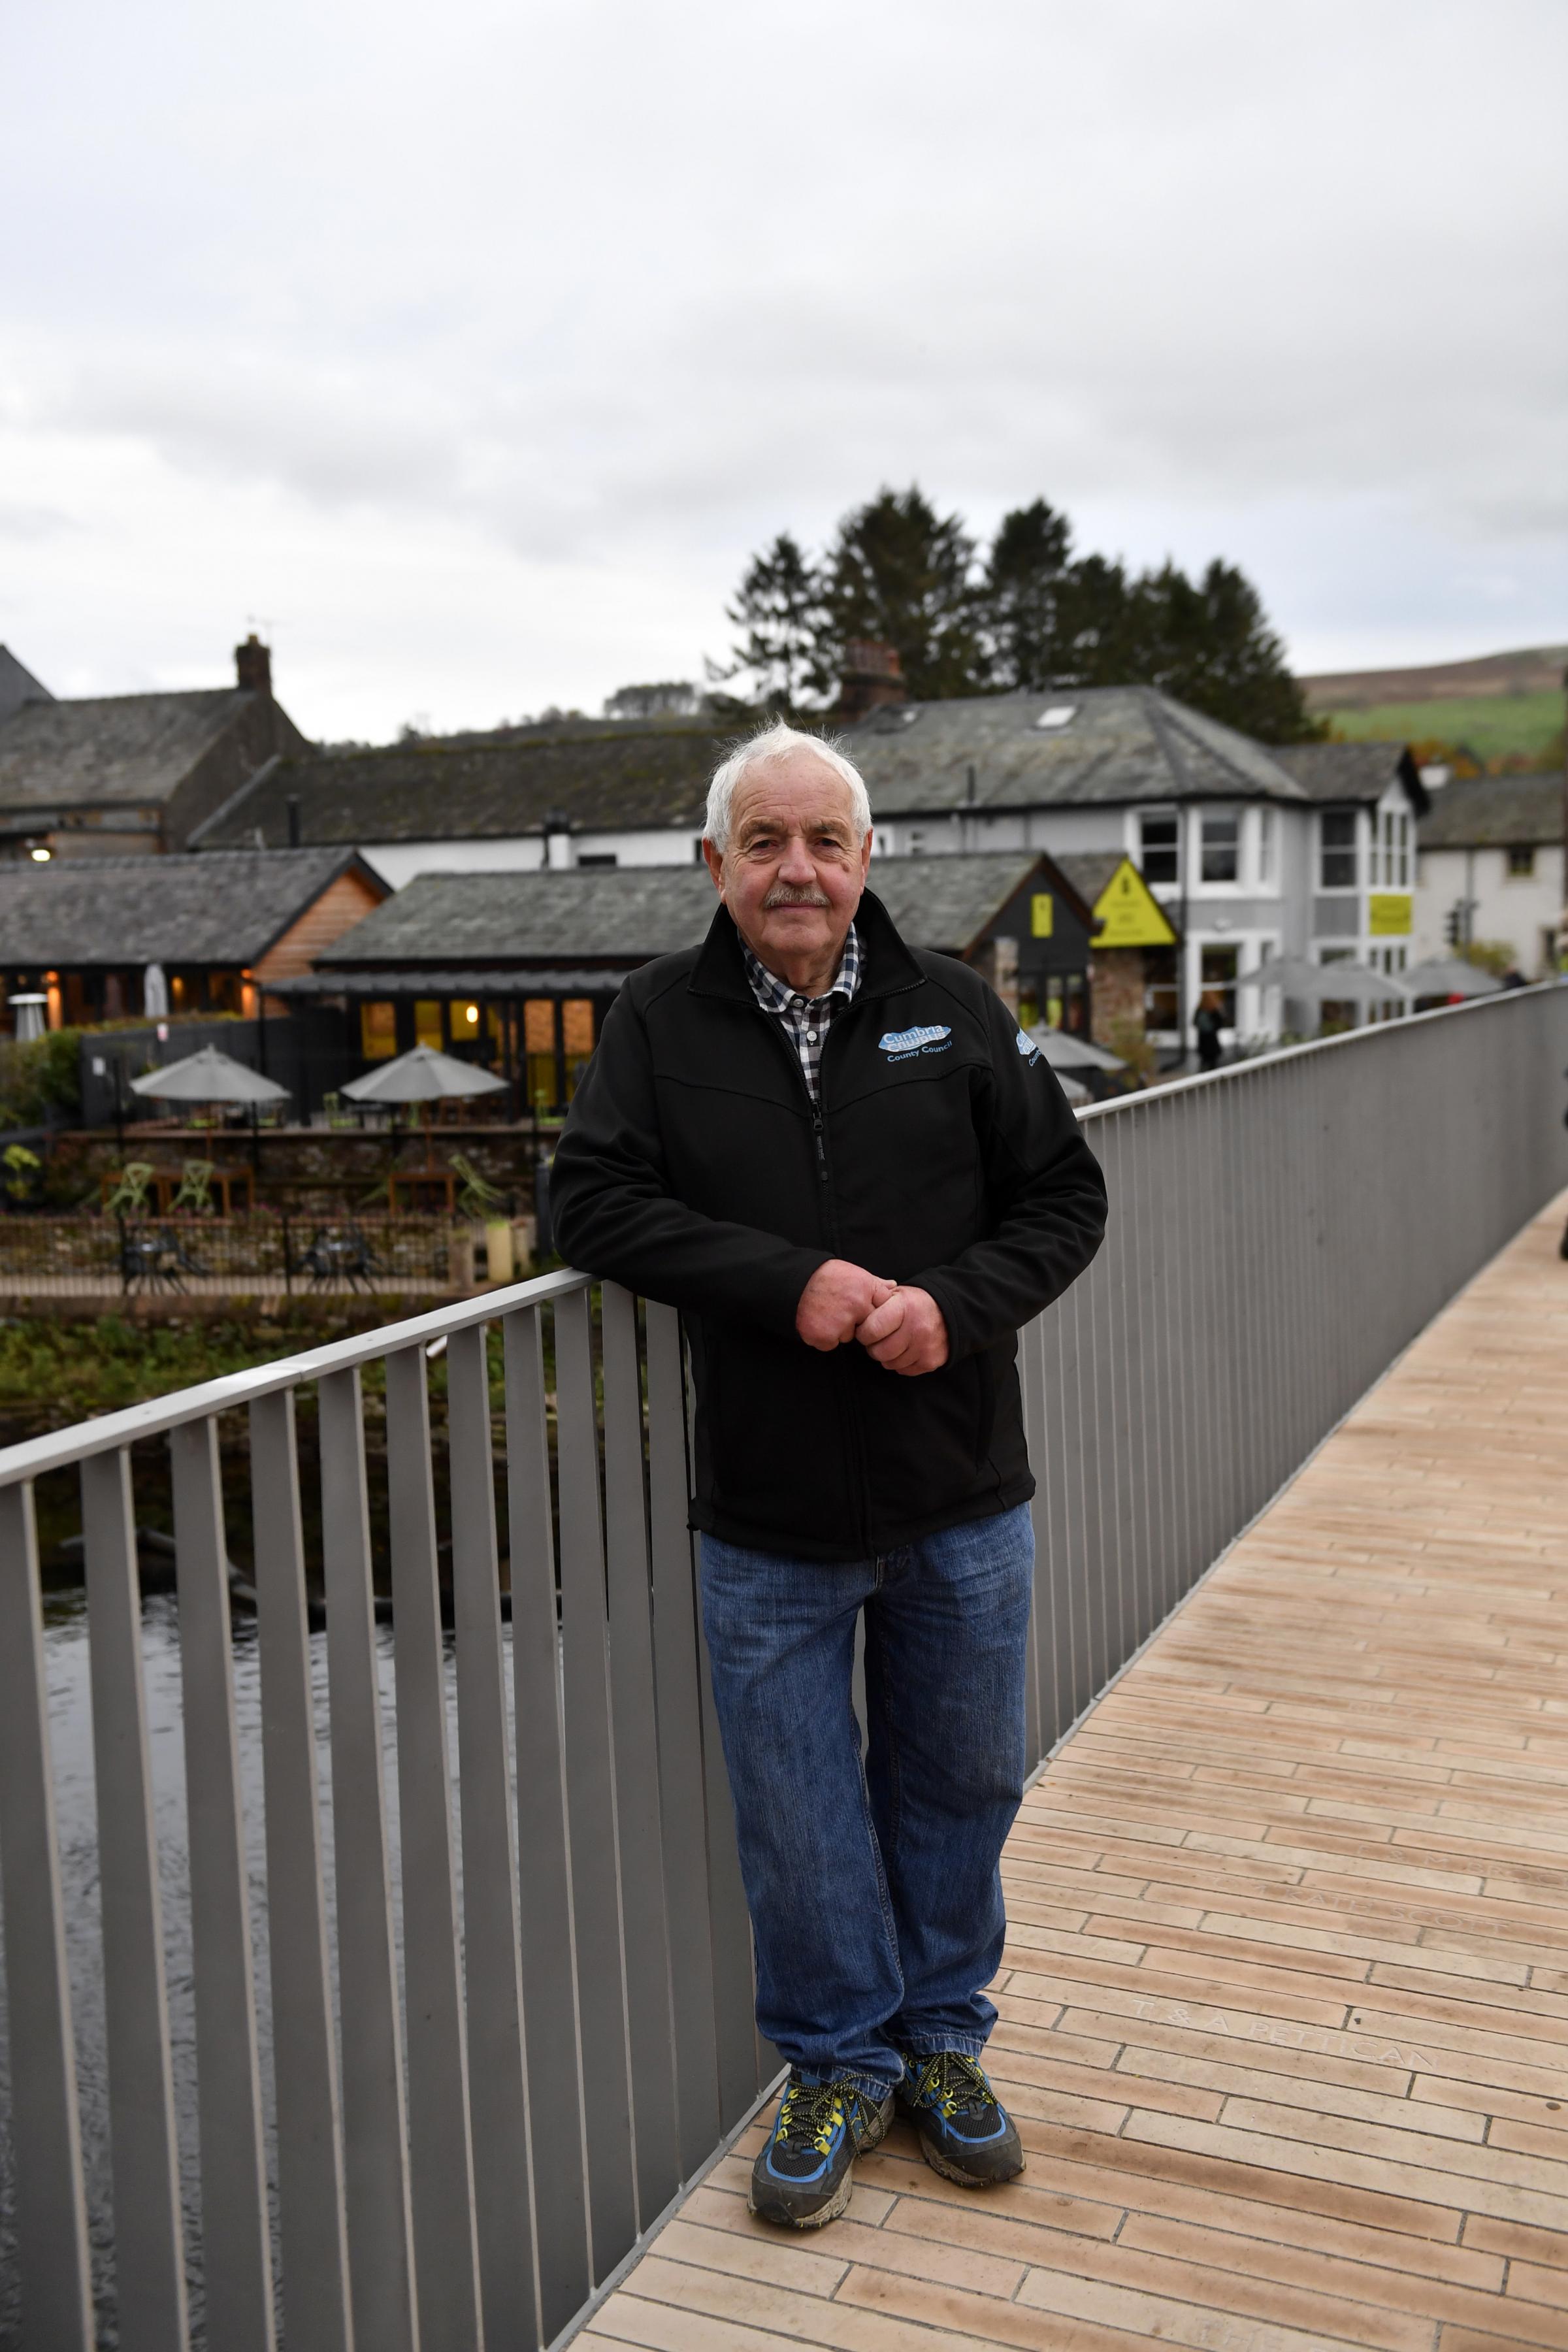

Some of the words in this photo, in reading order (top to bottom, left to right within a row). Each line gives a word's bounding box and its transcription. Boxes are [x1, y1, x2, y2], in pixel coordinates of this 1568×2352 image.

[883, 1025, 944, 1043] Cumbria
[887, 1050, 919, 1062] County
[921, 1040, 953, 1053] Council
[1422, 1854, 1448, 1868] M
[1468, 1861, 1568, 1887] BROC
[1286, 1888, 1374, 1912] KATH
[1391, 1906, 1509, 1935] SCOTT
[1131, 1998, 1155, 2016] T
[1166, 2008, 1192, 2026] &
[1203, 2013, 1230, 2031] A
[1249, 2020, 1437, 2070] PETTICAN
